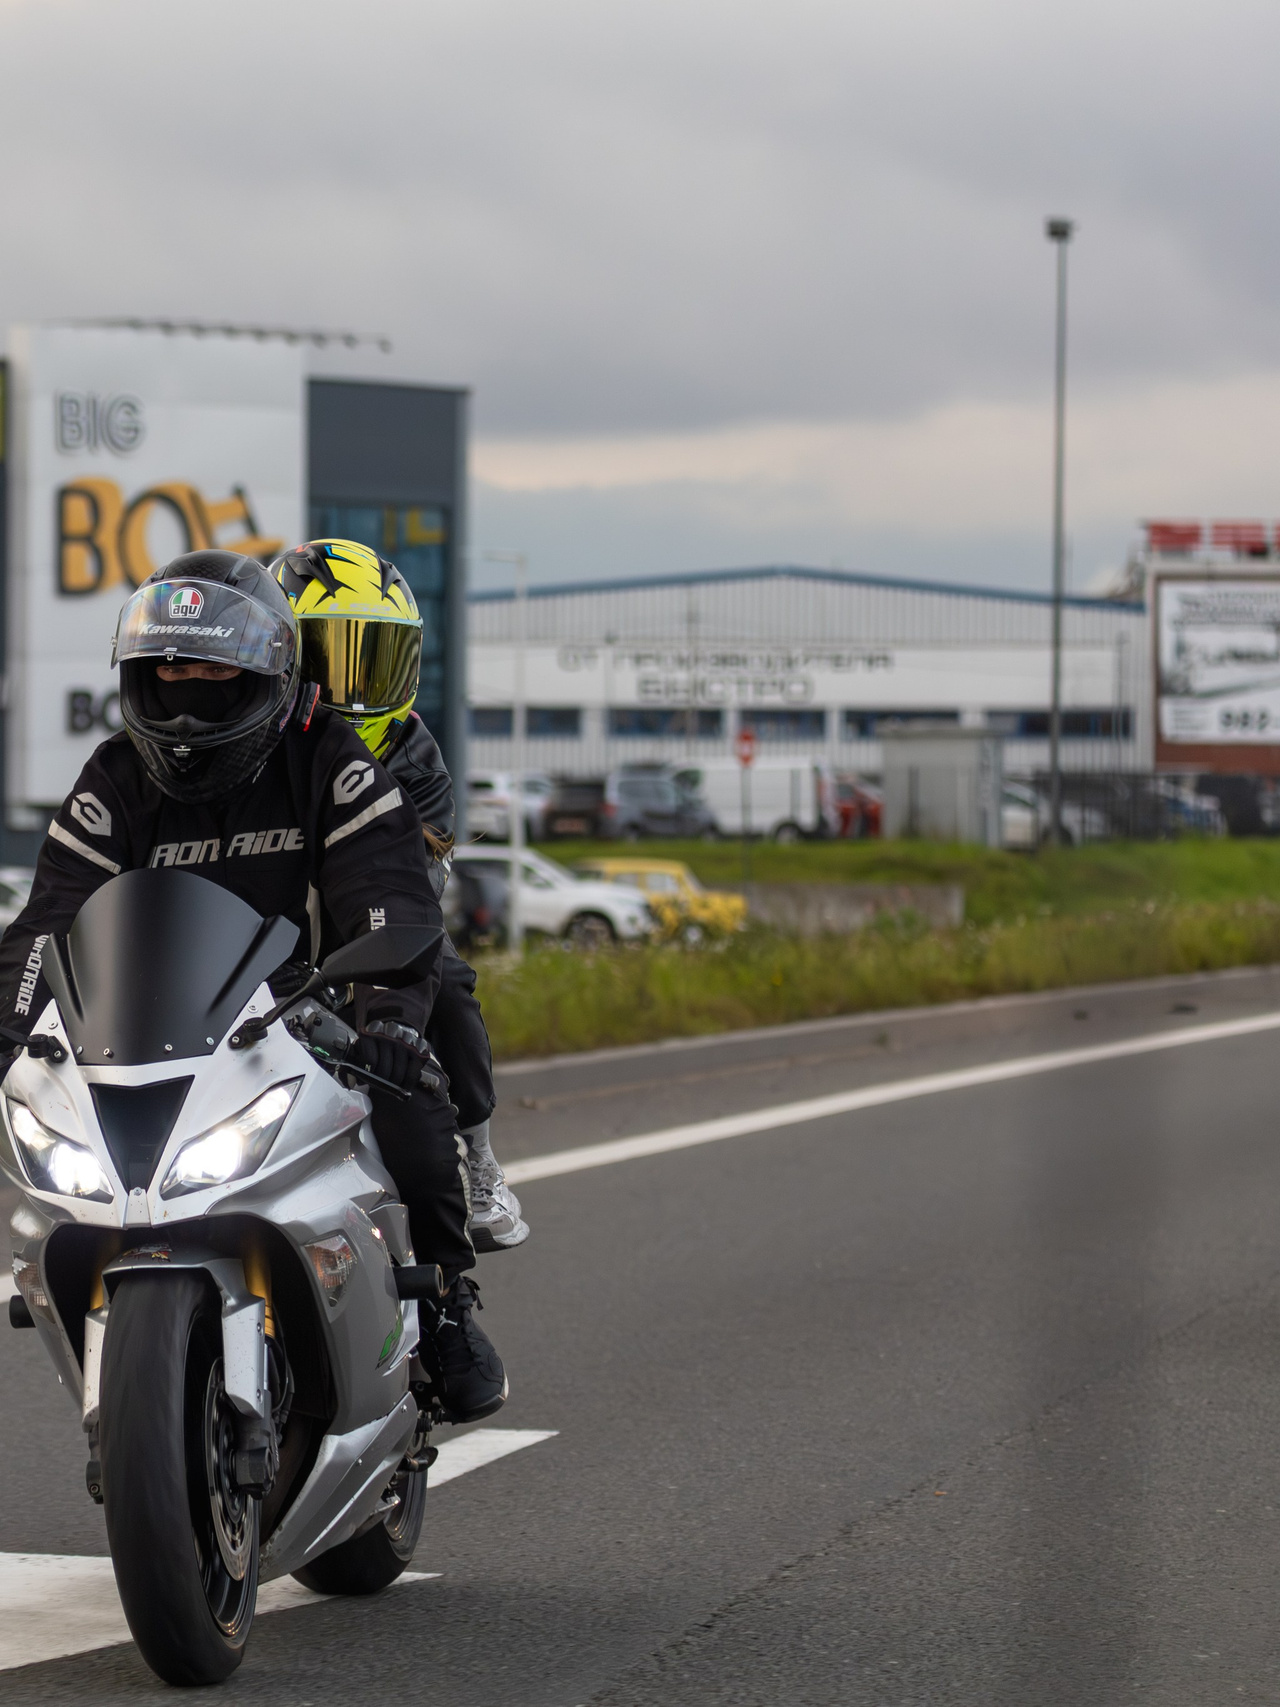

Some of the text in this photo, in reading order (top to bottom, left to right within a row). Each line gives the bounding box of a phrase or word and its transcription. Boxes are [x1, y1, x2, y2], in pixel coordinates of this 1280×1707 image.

[55, 393, 145, 455] BIG
[173, 604, 198, 616] agv
[328, 602, 391, 614] LS2
[139, 624, 235, 638] Kawasaki
[66, 688, 125, 735] BO
